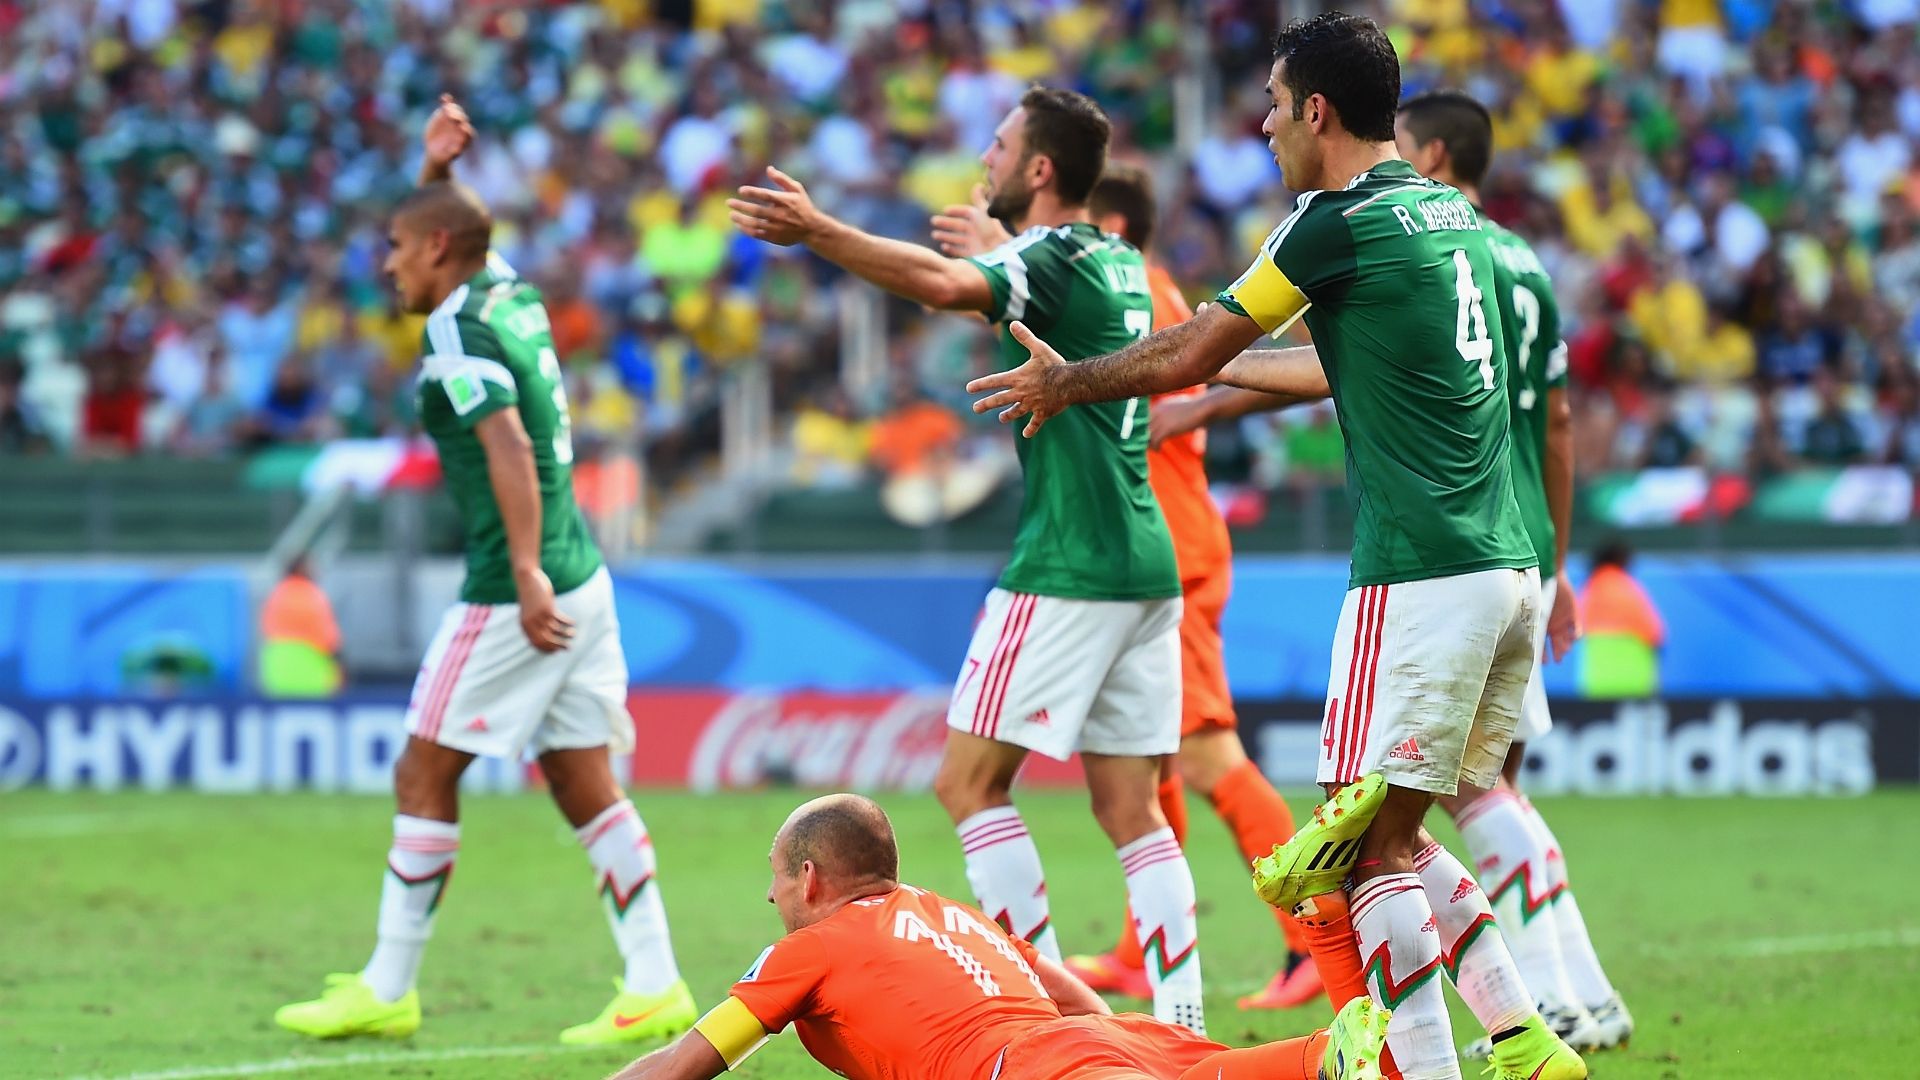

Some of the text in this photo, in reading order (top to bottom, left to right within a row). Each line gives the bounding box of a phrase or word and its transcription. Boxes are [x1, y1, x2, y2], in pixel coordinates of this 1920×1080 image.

[1391, 199, 1482, 236] R. MARQUE
[1452, 248, 1495, 390] 4
[46, 705, 527, 793] HYUND
[1323, 697, 1339, 761] 4
[1389, 750, 1425, 761] adidas
[1518, 699, 1875, 798] adidas
